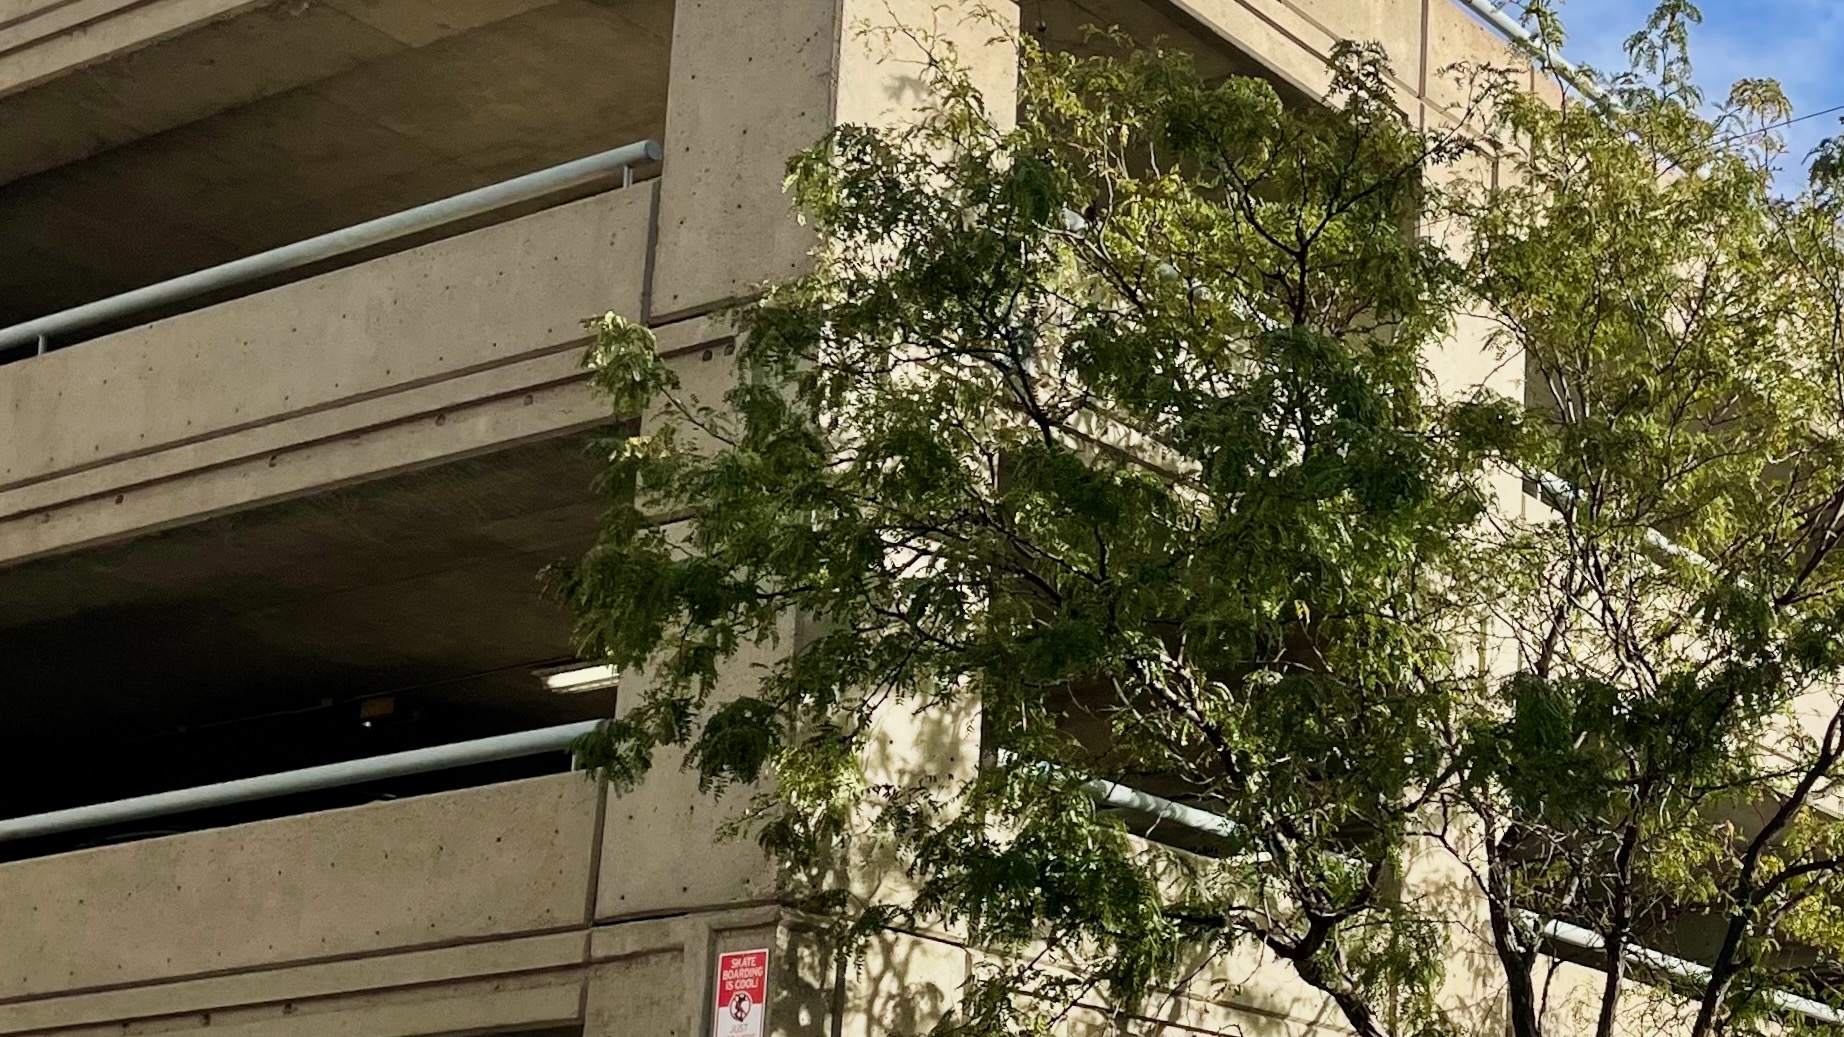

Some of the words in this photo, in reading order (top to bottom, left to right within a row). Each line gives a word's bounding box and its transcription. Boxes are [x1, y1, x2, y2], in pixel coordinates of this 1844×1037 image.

[731, 957, 756, 969] SKATE
[722, 966, 763, 980] BOARDING
[725, 981, 734, 990] IS
[730, 1023, 749, 1034] JUST
